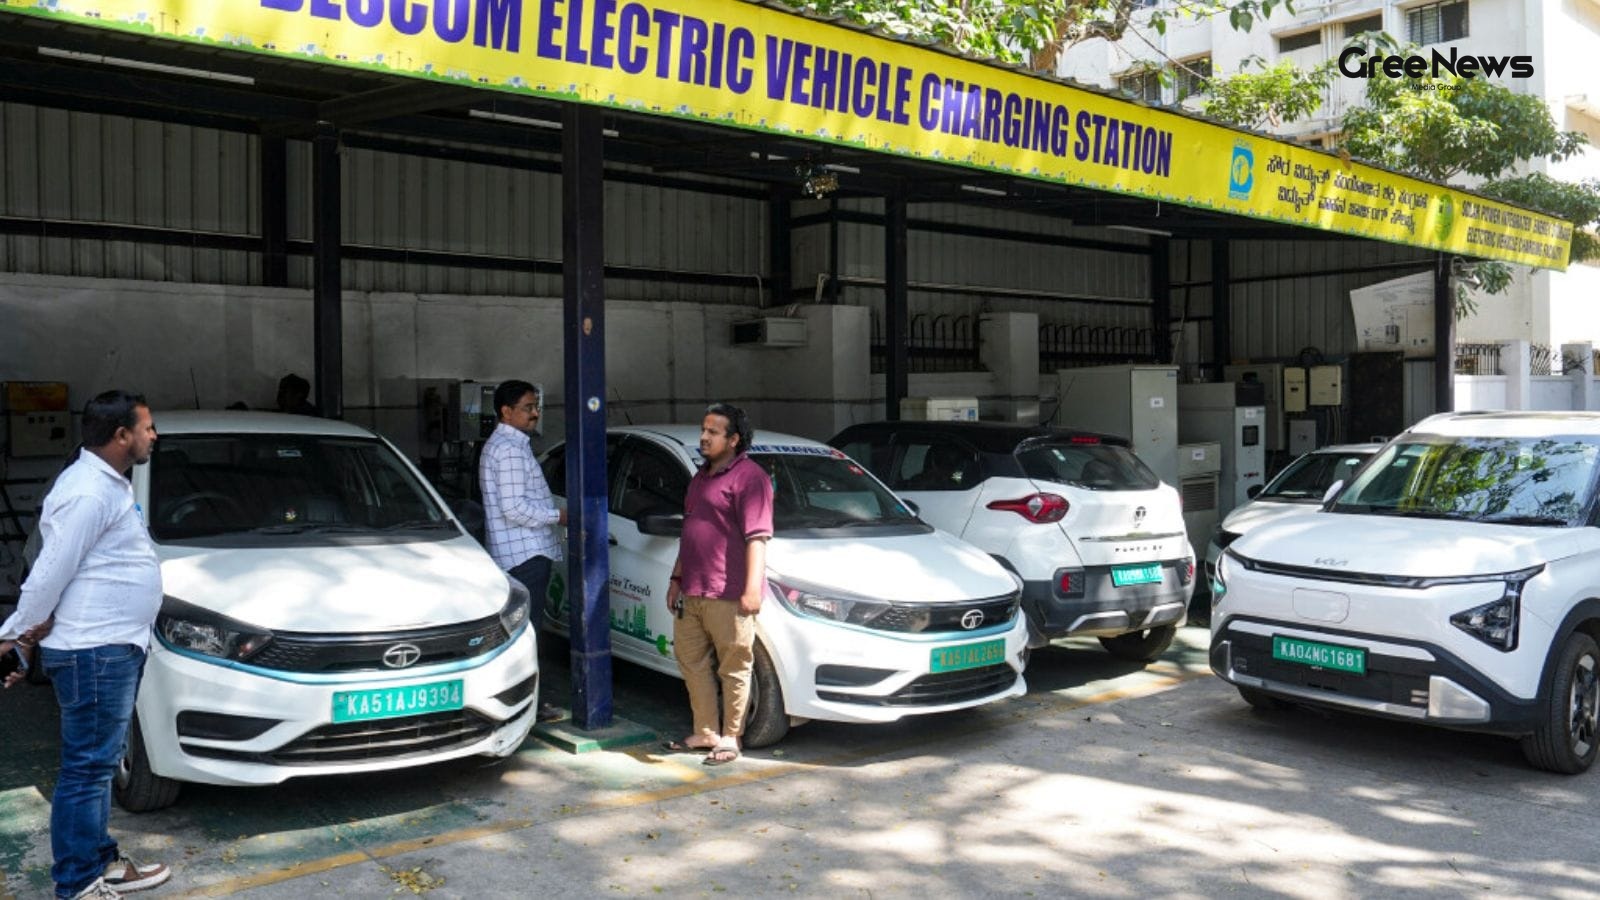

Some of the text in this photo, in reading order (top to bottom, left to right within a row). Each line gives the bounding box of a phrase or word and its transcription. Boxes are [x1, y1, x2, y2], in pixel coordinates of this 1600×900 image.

[537, 0, 755, 95] ELECTRIC
[766, 36, 913, 126] VEHICLE
[919, 73, 1068, 158] CHARGING
[1074, 110, 1173, 178] STATION
[347, 686, 460, 717] KA51AJ9394
